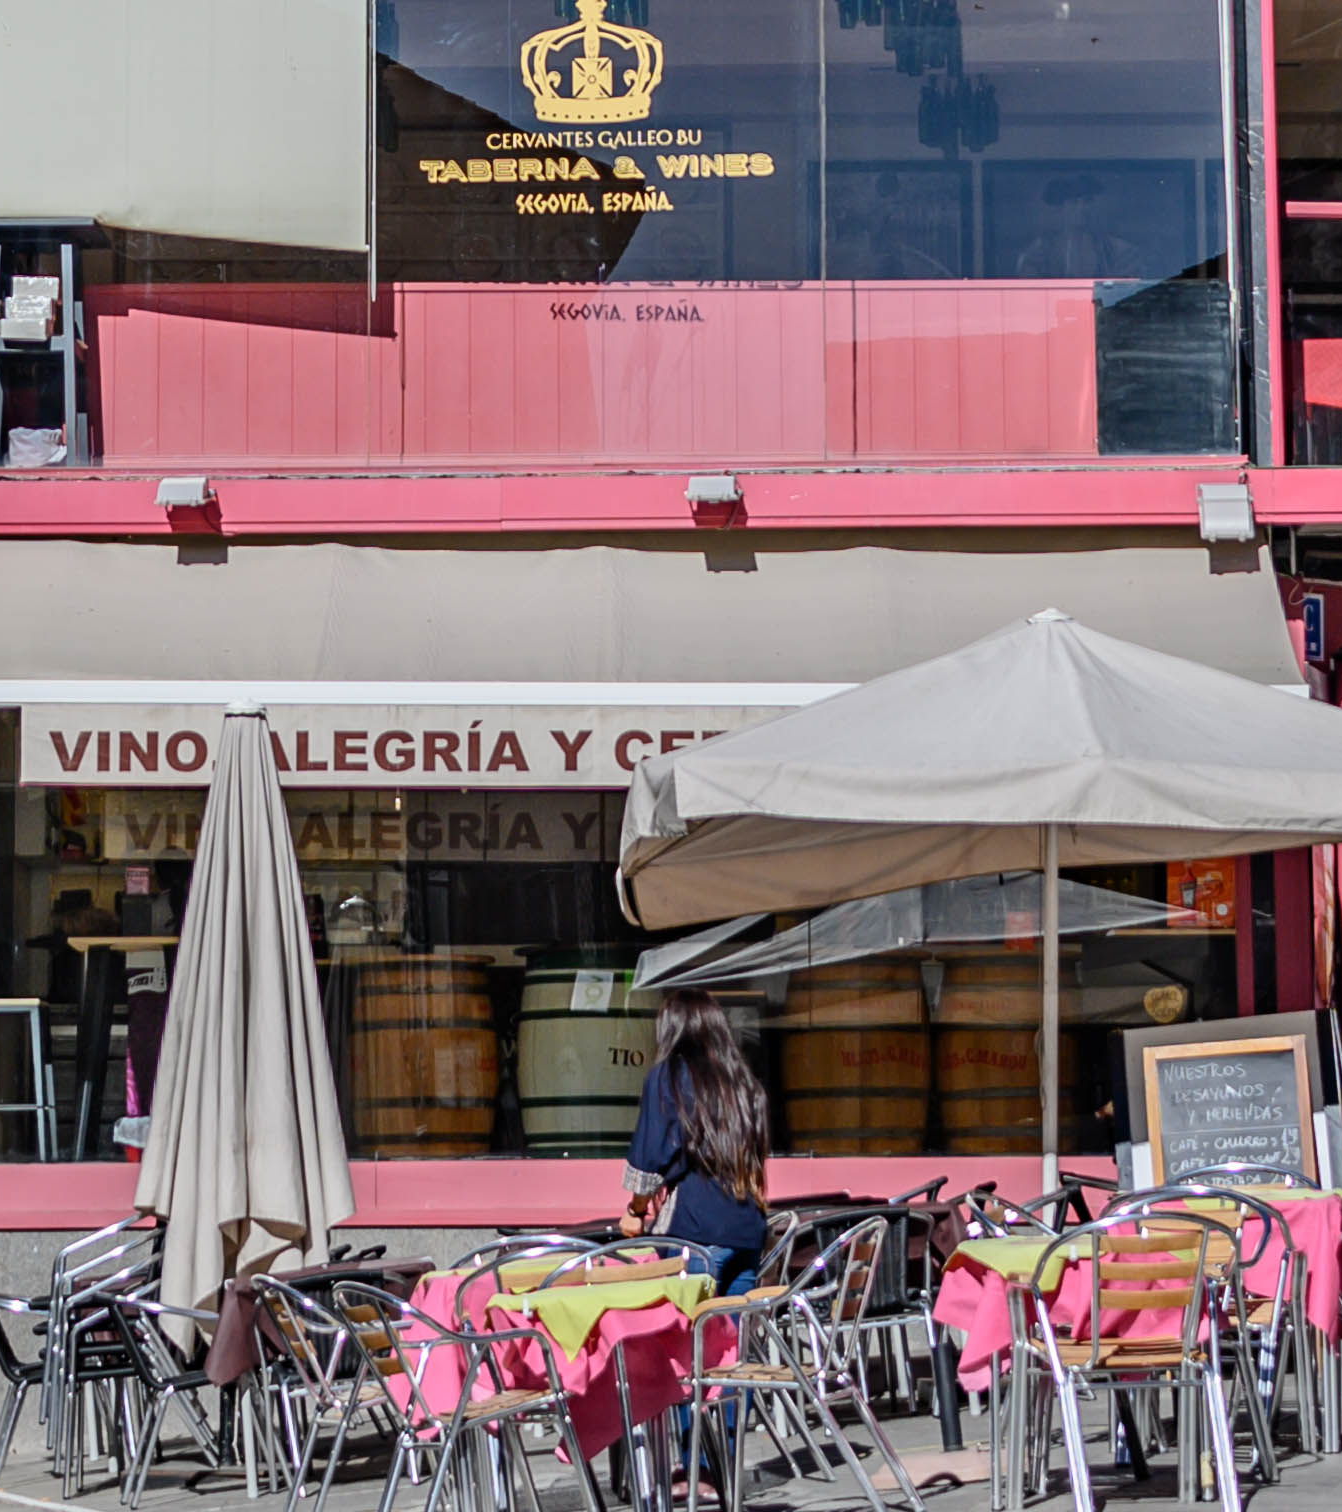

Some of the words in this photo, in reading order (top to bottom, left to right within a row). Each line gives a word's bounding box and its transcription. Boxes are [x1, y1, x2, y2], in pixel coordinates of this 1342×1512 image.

[486, 132, 594, 150] CERVANTES
[597, 130, 673, 149] GALLEO
[676, 129, 702, 146] BU
[419, 157, 601, 183] TABERNA
[613, 156, 645, 180] &
[657, 153, 774, 177] WINES
[49, 730, 216, 772] VINO
[551, 730, 593, 771] Y
[608, 1048, 645, 1067] TIO
[1164, 1062, 1247, 1084] NUESTROS
